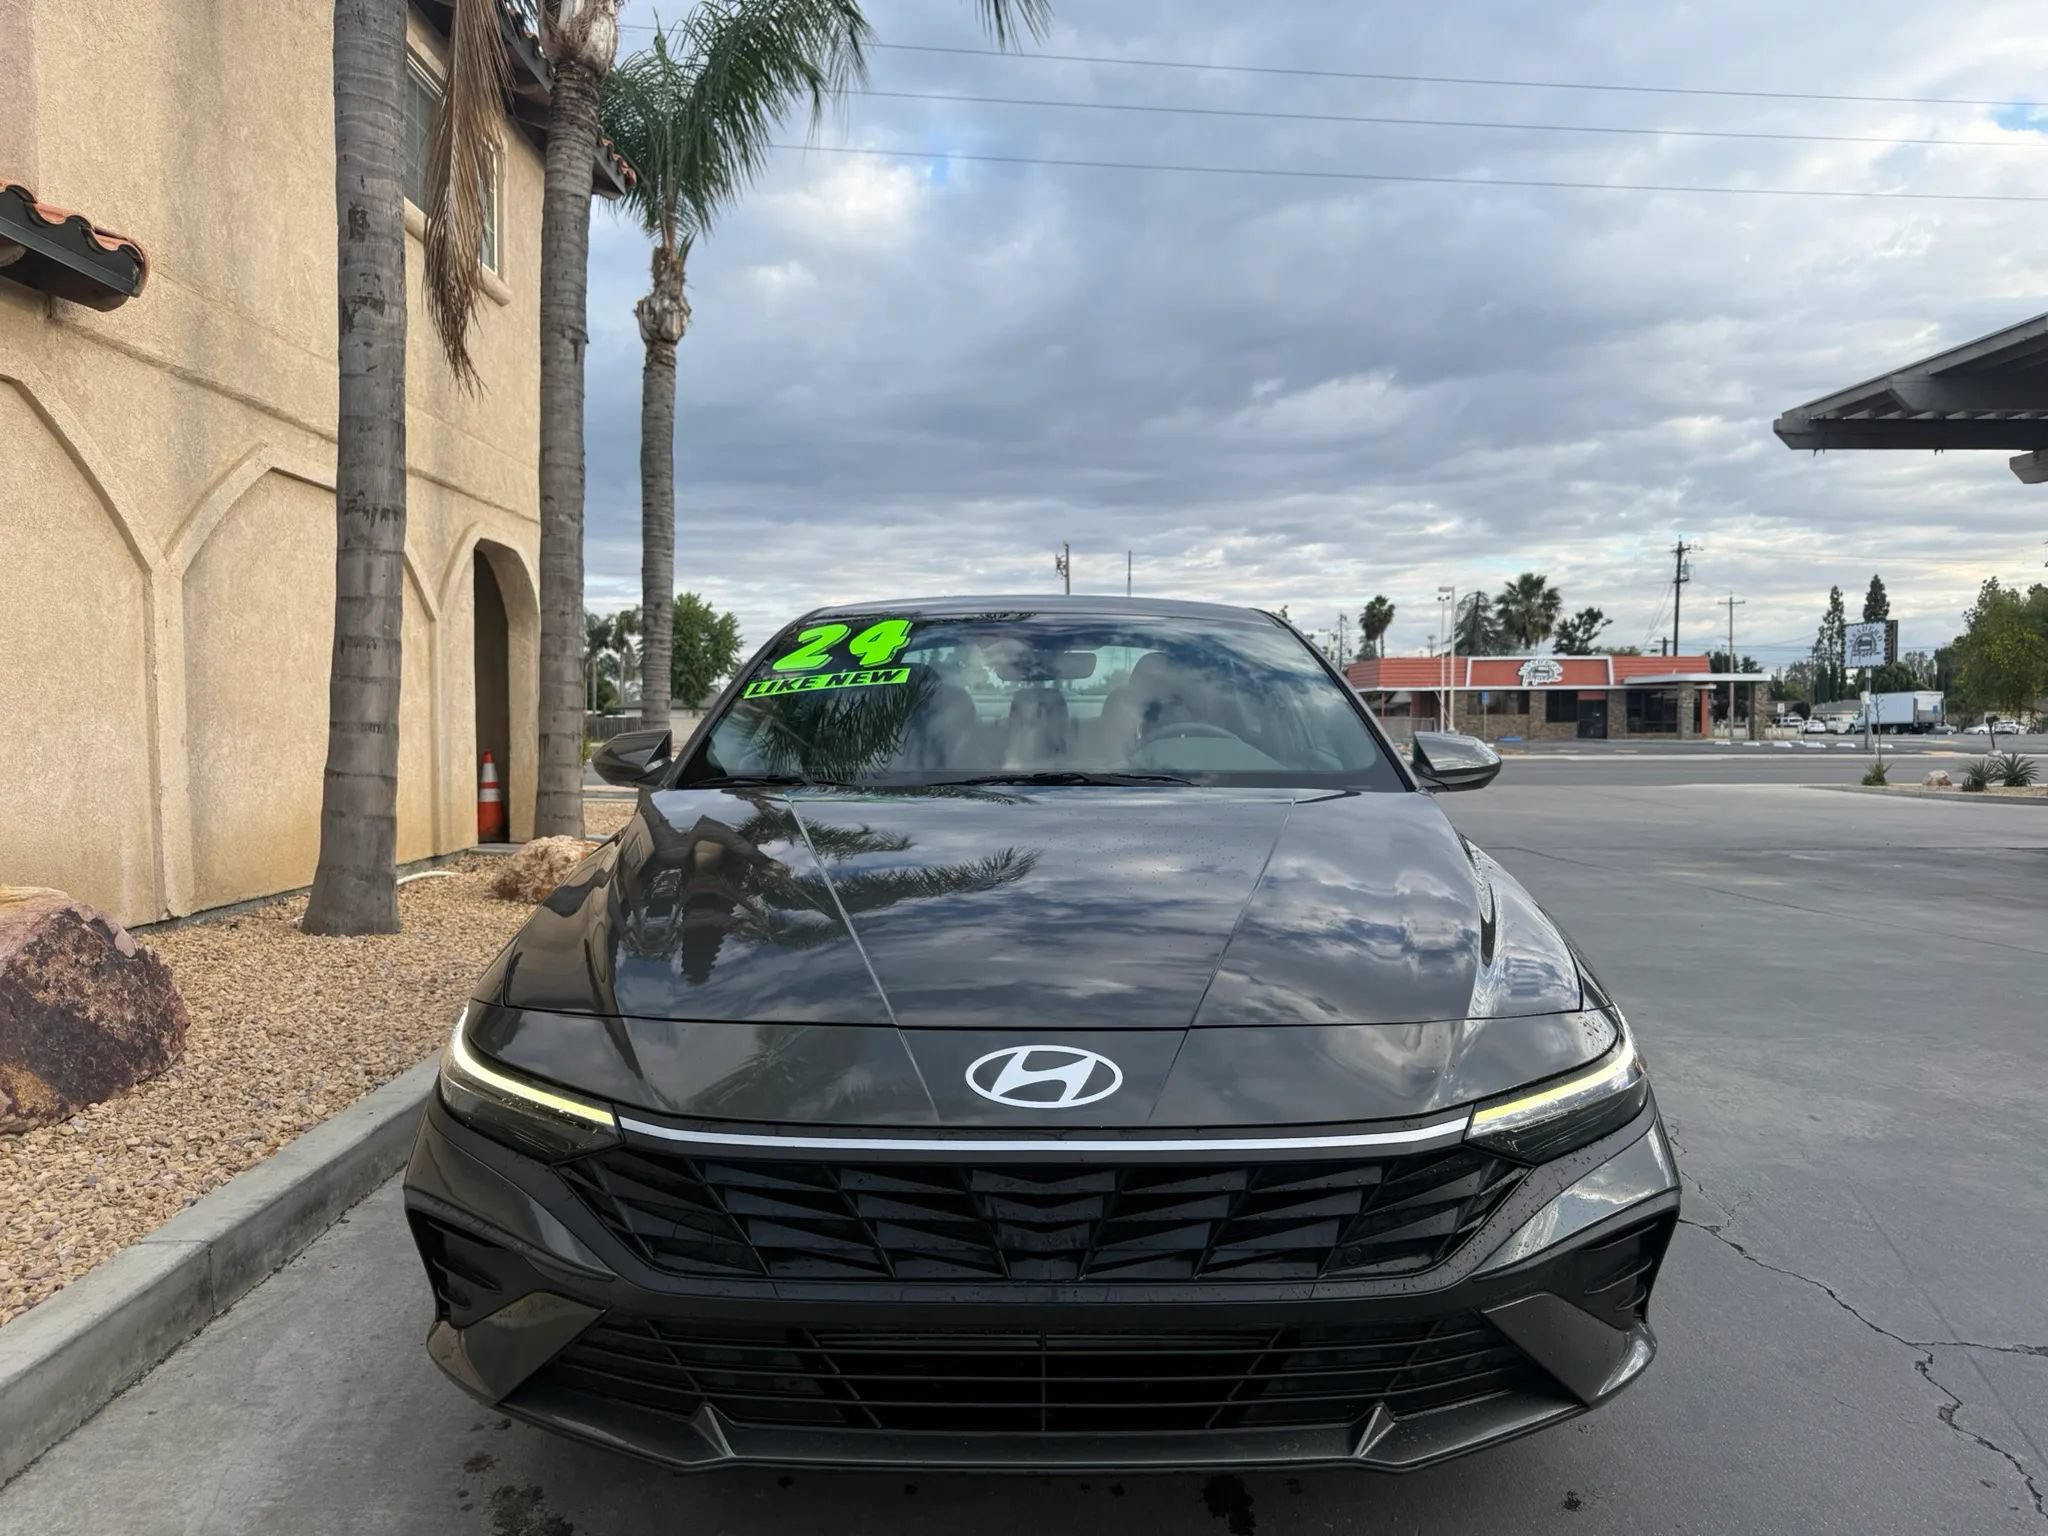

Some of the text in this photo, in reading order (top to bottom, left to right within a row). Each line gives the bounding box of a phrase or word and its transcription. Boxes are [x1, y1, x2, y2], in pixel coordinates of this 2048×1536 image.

[772, 619, 913, 671] 24
[748, 669, 902, 695] LIKE NEW
